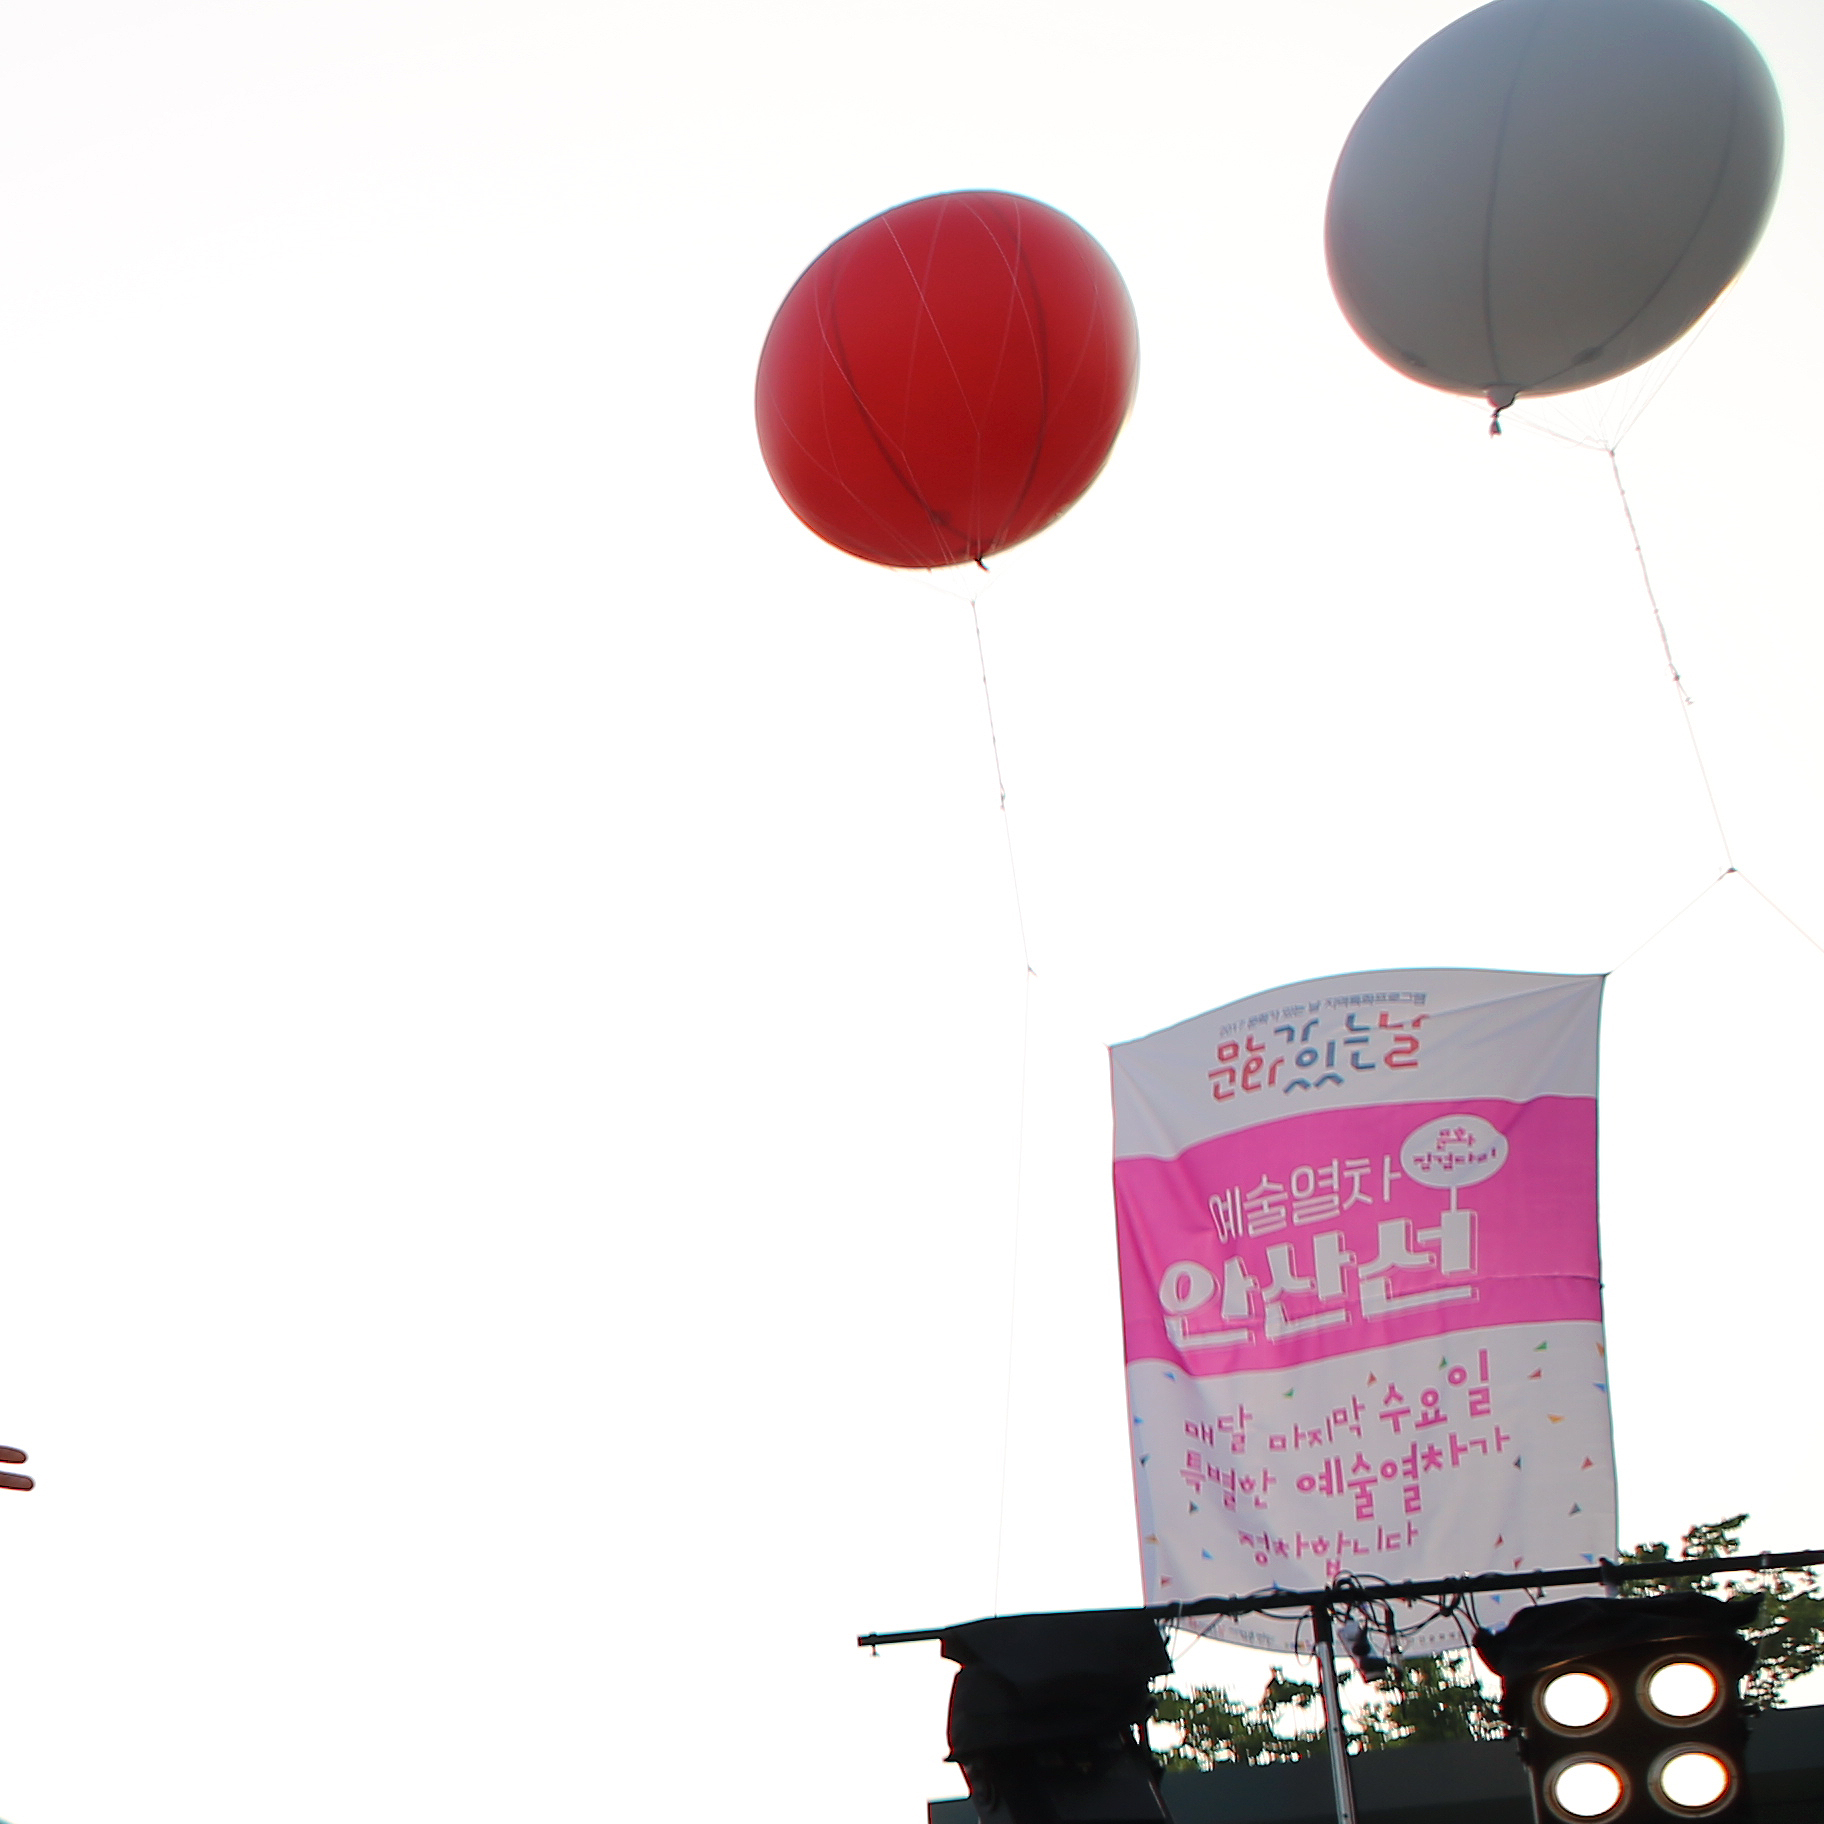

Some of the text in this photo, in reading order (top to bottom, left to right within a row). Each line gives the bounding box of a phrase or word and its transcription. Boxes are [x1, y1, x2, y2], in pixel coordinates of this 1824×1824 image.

[1208, 1154, 1403, 1244] 예술열차
[1158, 1208, 1480, 1350] 안산선
[1184, 1348, 1493, 1455] 매달 마지막 수요일
[1180, 1423, 1512, 1521] 특별한 예술열차가
[1237, 1519, 1420, 1581] 정차합니다
